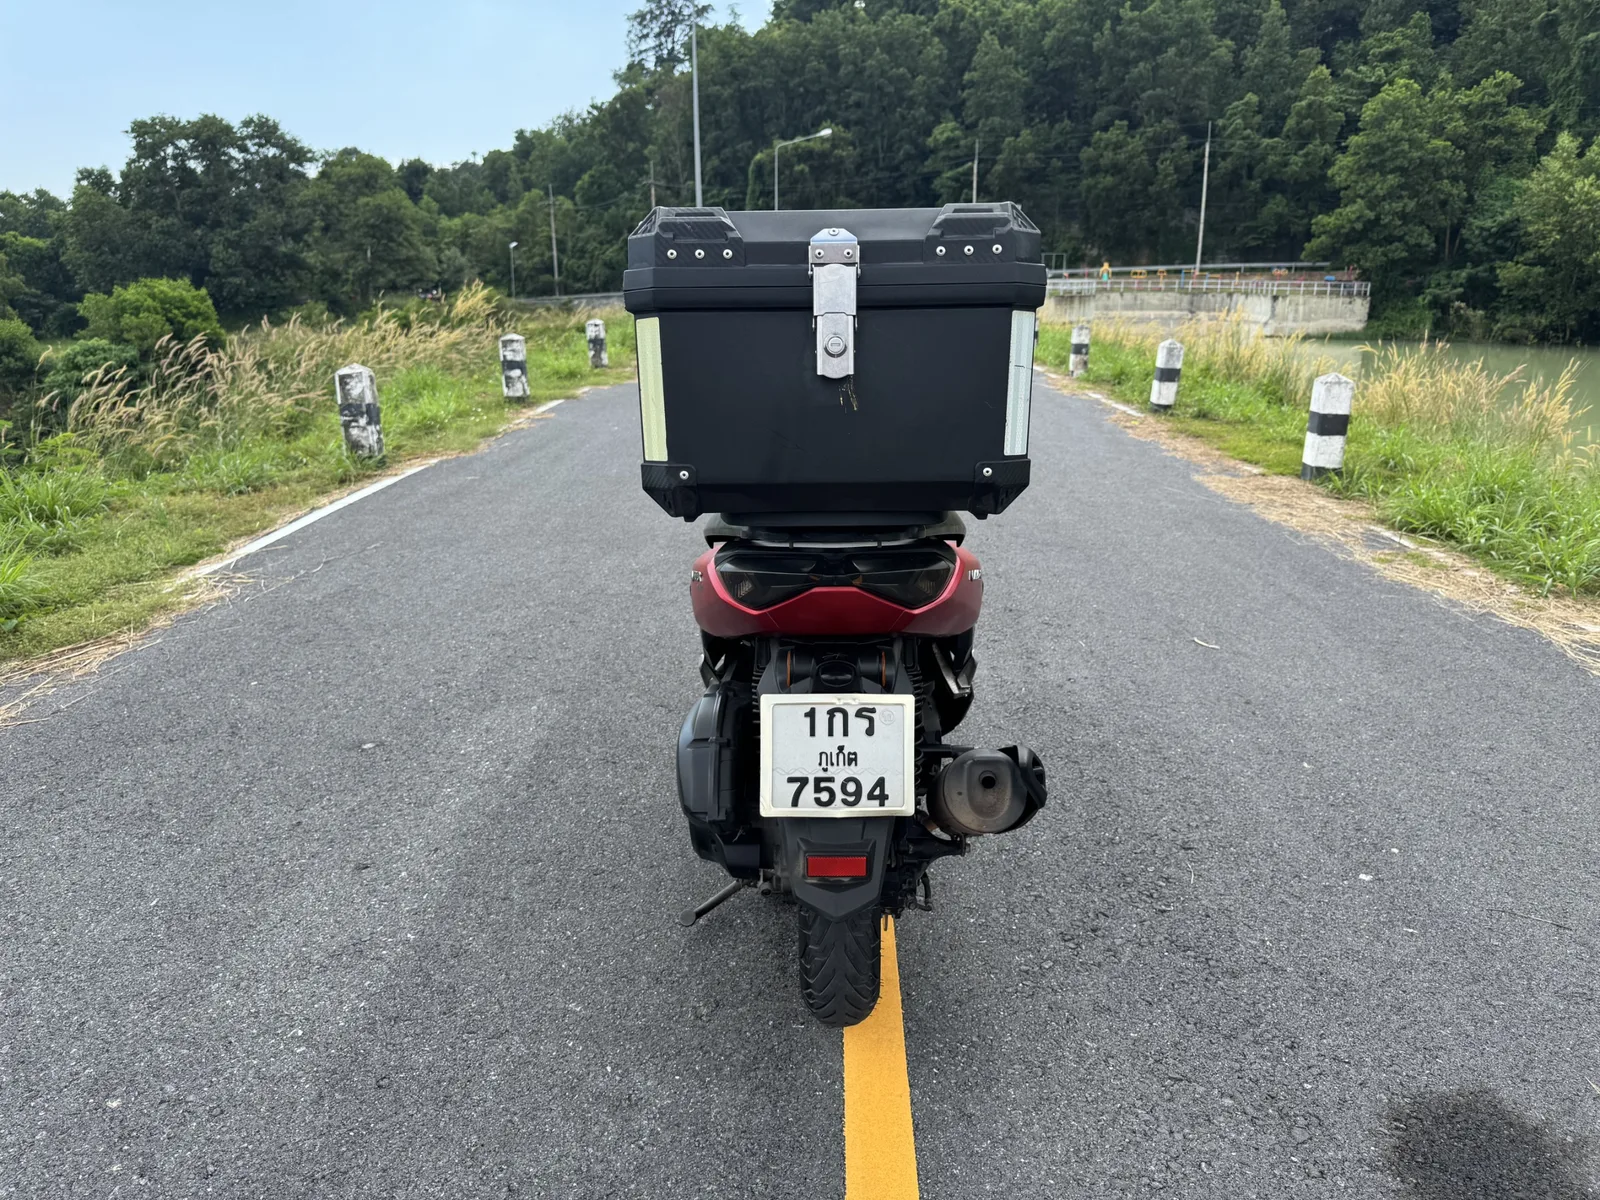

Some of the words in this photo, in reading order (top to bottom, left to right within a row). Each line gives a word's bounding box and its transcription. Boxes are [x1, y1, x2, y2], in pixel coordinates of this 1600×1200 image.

[804, 707, 877, 737] 1กร
[818, 745, 858, 772] ภูเก็ต
[786, 776, 889, 807] 7594
